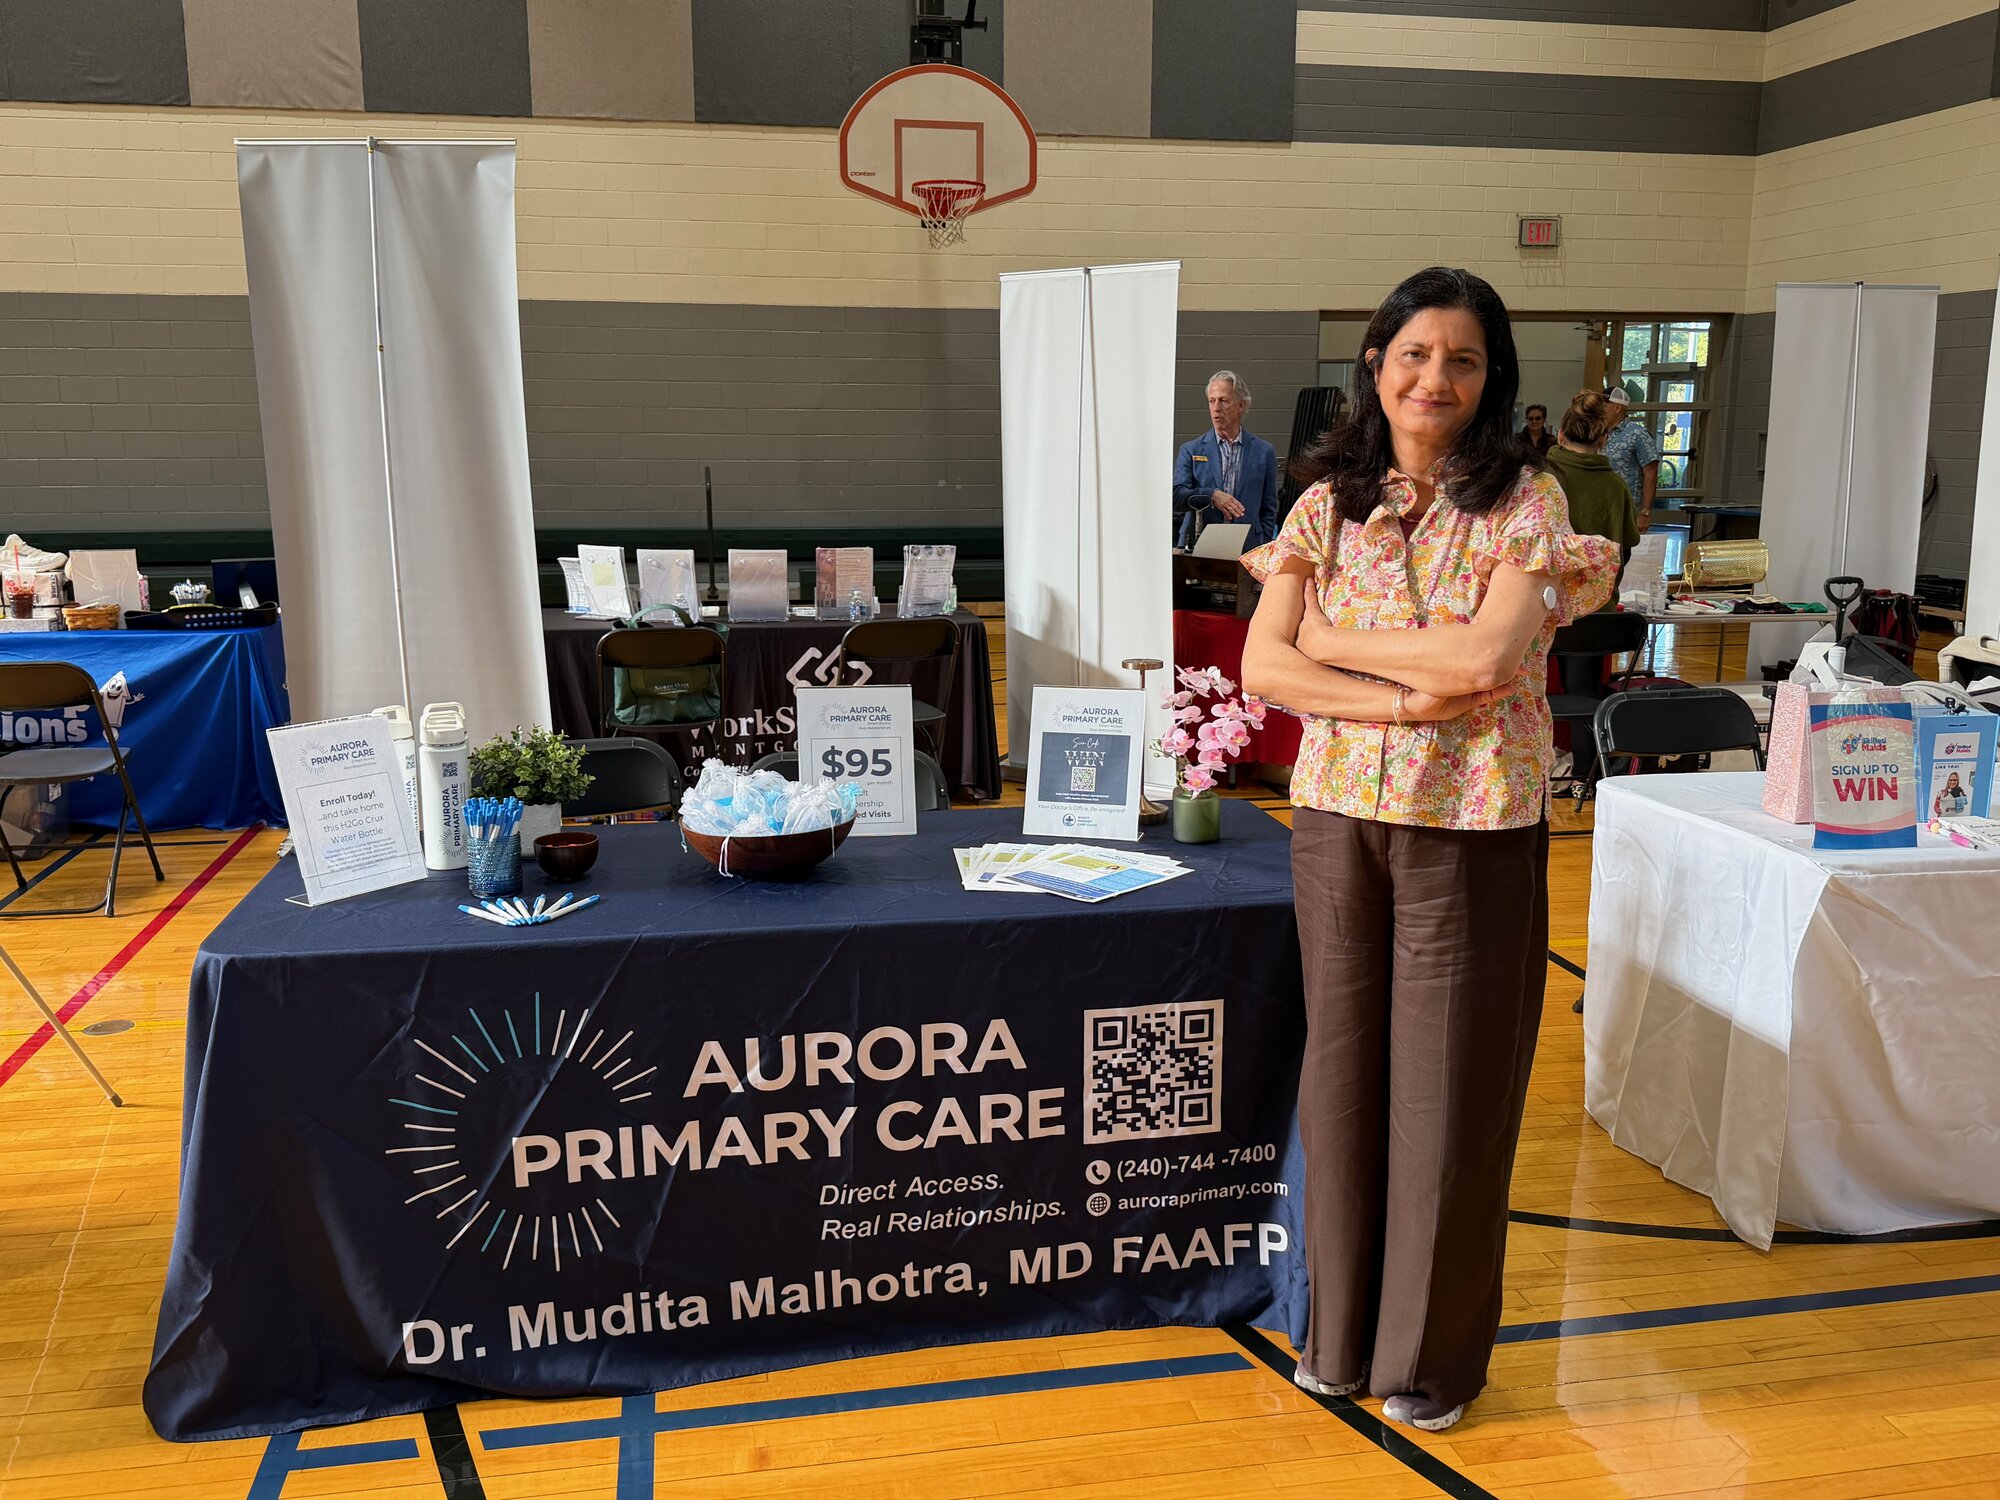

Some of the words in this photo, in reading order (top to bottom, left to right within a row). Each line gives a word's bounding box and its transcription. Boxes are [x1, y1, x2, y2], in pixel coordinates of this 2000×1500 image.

[1527, 222, 1552, 242] EXIT
[830, 715, 867, 723] PRIMARY
[869, 714, 892, 722] CARE
[850, 706, 887, 714] AURORA
[1082, 707, 1119, 716] AURORA
[0, 711, 88, 744] ions
[1062, 715, 1100, 724] PRIMARY
[1100, 716, 1123, 725] CARE
[330, 739, 369, 753] AURORA
[1861, 743, 1887, 751] Maids
[311, 751, 349, 766] PRIMARY
[351, 748, 375, 759] CARE
[822, 745, 892, 781] $95
[1831, 765, 1860, 775] SIGN
[1863, 764, 1880, 774] UP
[1882, 763, 1899, 774] TO
[319, 795, 346, 807] Enroll
[347, 790, 376, 802] Today!
[1832, 776, 1899, 802] WIN
[340, 806, 359, 817] take
[360, 801, 385, 812] home
[442, 788, 452, 827] AURORA
[869, 810, 892, 818] Visits
[323, 822, 340, 833] this
[341, 818, 364, 830] H2Go
[365, 815, 385, 826] Crux
[452, 808, 461, 847] PRIMARY
[331, 833, 357, 845] Water
[358, 827, 383, 839] Bottle
[682, 1018, 1027, 1098] AURORA
[512, 1106, 858, 1188] PRIMARY
[876, 1087, 1066, 1151] CARE
[1116, 1152, 1215, 1183] (240)-744
[1221, 1143, 1276, 1167] -7400
[819, 1178, 897, 1206] Direct
[904, 1173, 1004, 1198] Access.
[1117, 1182, 1289, 1210] auroraprimary.com
[820, 1215, 881, 1241] Real
[887, 1199, 1066, 1233] Relationships.
[402, 1319, 487, 1366] Dr.
[507, 1289, 710, 1352] Mudita
[729, 1260, 988, 1320] Malhotra,
[1009, 1241, 1093, 1285] MD
[1112, 1222, 1289, 1274] FAAFP
